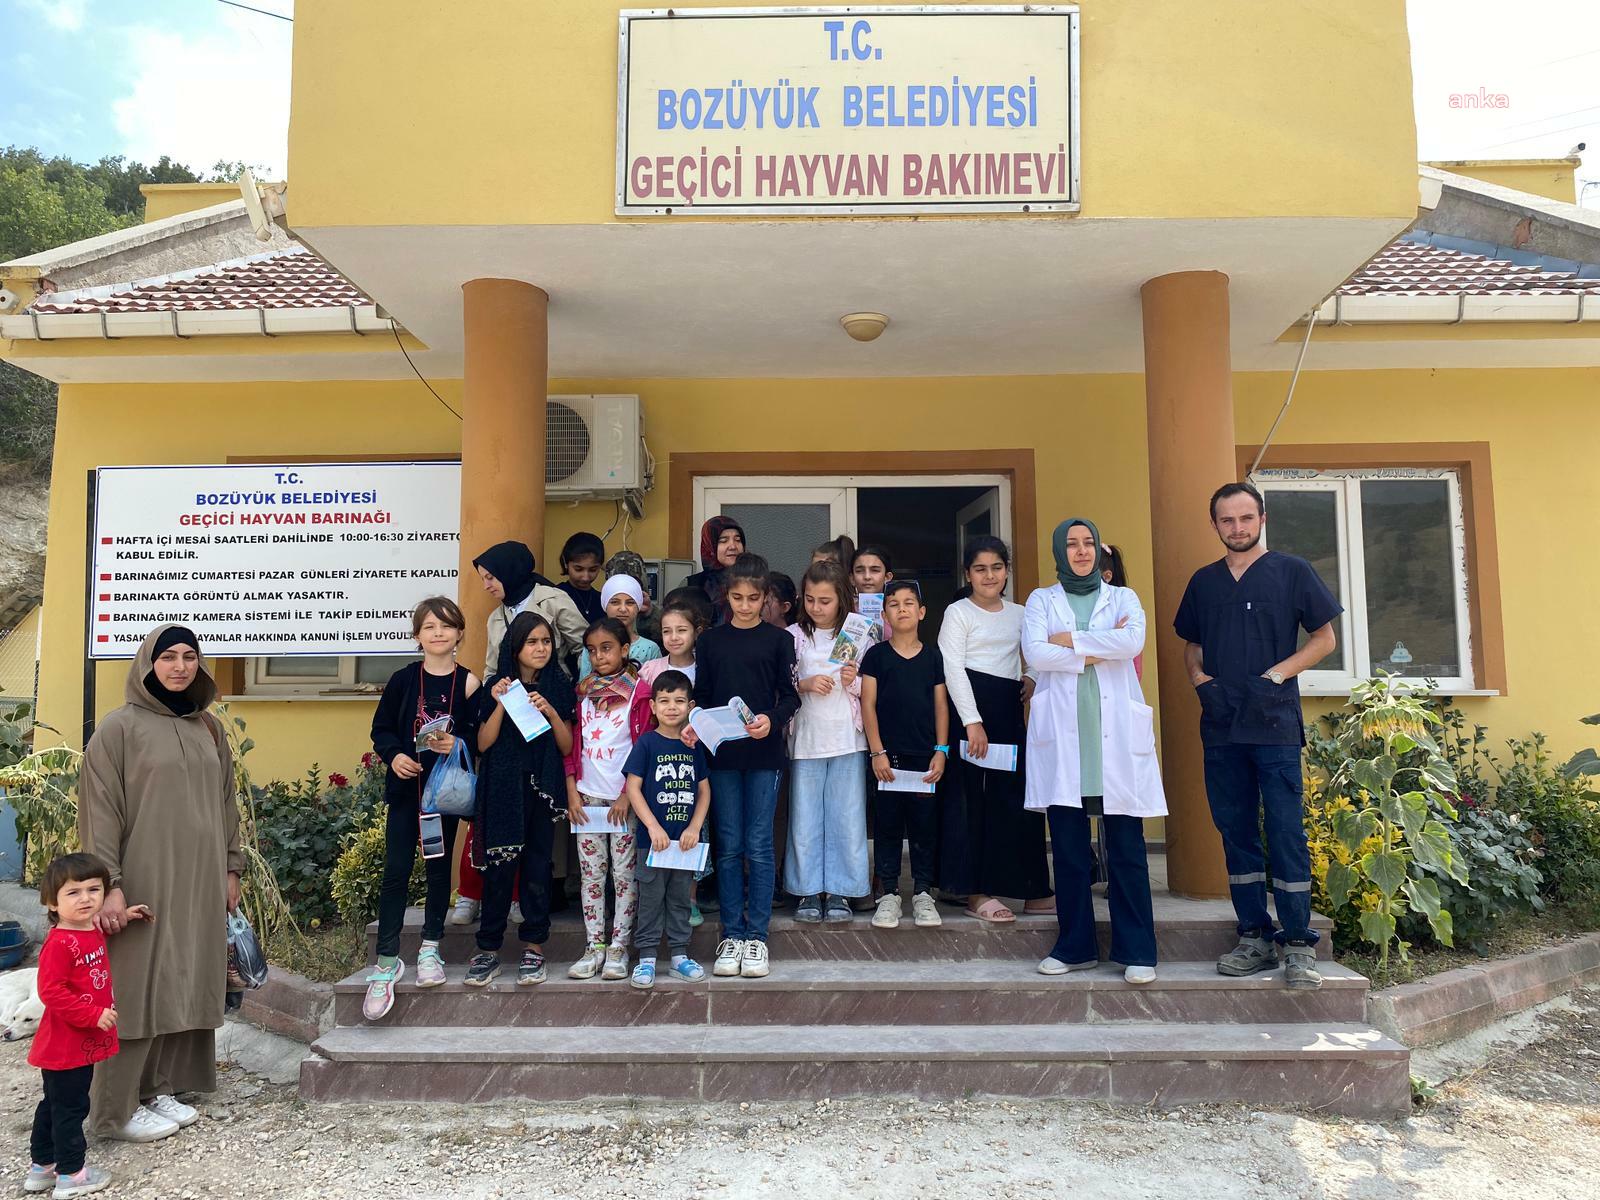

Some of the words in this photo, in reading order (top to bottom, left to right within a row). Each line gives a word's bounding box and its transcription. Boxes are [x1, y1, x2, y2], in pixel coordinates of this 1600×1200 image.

[824, 20, 882, 60] T.C.
[657, 79, 820, 130] BOZÜYÜK
[843, 76, 1037, 127] BELEDİYESİ
[630, 146, 742, 206] GEÇİCİ
[755, 154, 889, 197] HAYVAN
[903, 143, 1066, 196] BAKIMEVİ
[274, 473, 303, 484] T.C.
[196, 490, 276, 505] BOZÜYÜK
[281, 489, 377, 504] BELEDİYESİ
[179, 511, 234, 528] GEÇİCİ
[240, 513, 306, 525] HAYVAN
[311, 509, 391, 524] BARINAĞI
[116, 536, 153, 545] HAFTA
[156, 535, 172, 547] İÇİ
[175, 534, 211, 545] MESAİ
[214, 533, 269, 544] SAATLERİ
[272, 533, 334, 543] DAHİLİNDE
[339, 533, 404, 542] 10:00-16:30
[116, 551, 155, 560] KABUL
[158, 549, 199, 560] EDİLİR.
[114, 570, 188, 581] BARINAĞIMIZ
[191, 569, 256, 580] CUMARTESİ
[258, 571, 295, 580] PAZAR
[300, 569, 350, 579] GÜNLERİ
[353, 568, 407, 579] ZİYARETE
[113, 592, 180, 602] BARINAKTA
[183, 590, 240, 601] GÖRÜNTÜ
[243, 591, 284, 600] ALMAK
[287, 591, 349, 600] YASAKTIR.
[113, 611, 190, 622] BARINAĞIMIZ
[193, 613, 242, 621] KAMERA
[244, 610, 291, 621] SİSTEMİ
[294, 610, 313, 620] İLE
[318, 609, 353, 619] TAKİP
[113, 633, 148, 643] YASAK
[196, 633, 242, 642] AYANLAR
[244, 632, 297, 642] HAKKINDA
[300, 631, 340, 642] KANUNİ
[342, 630, 373, 642] İŞLEM
[586, 747, 615, 760] WAY
[665, 780, 691, 790] MODE
[665, 813, 689, 822] ATED
